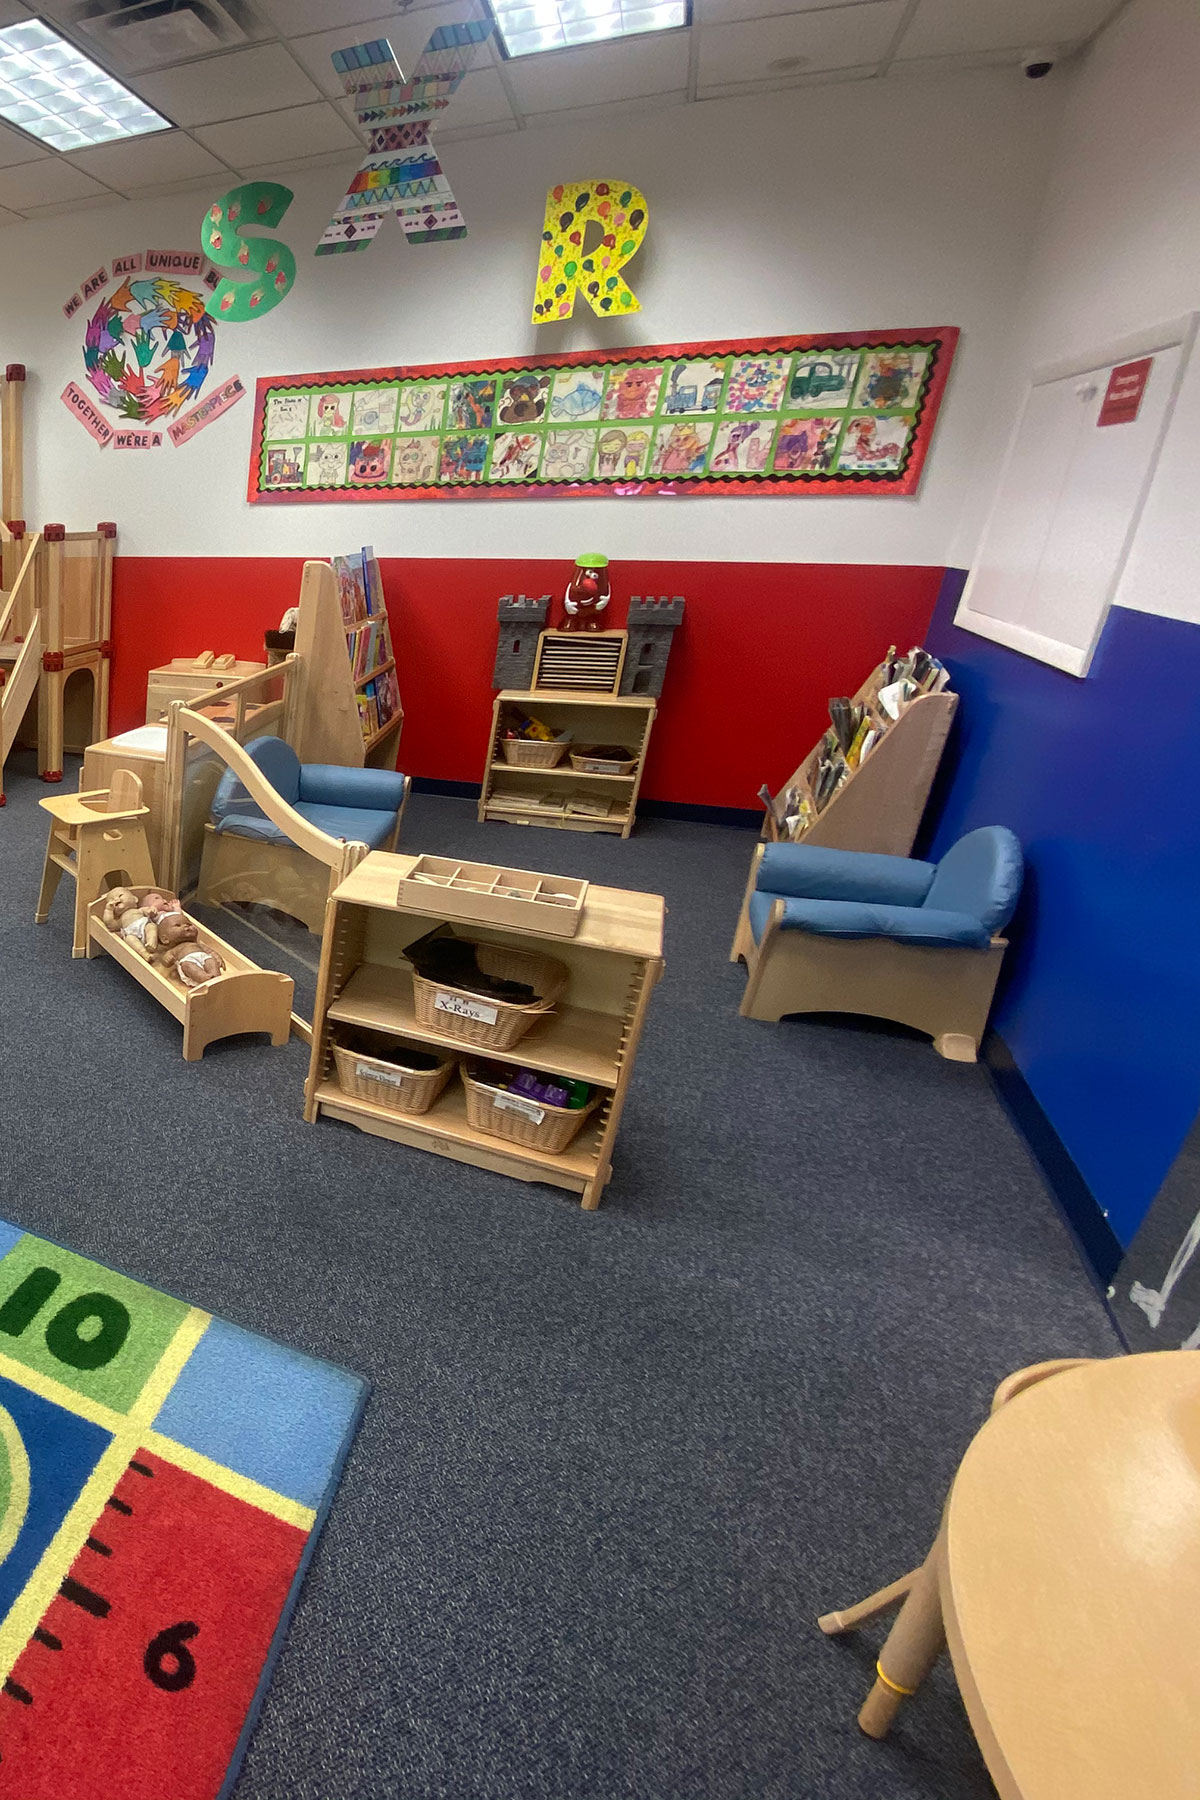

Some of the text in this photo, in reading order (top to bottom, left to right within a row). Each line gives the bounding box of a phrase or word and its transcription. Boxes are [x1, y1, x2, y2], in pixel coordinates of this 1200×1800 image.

[201, 181, 297, 322] S
[531, 179, 649, 324] R
[65, 297, 81, 314] WE
[84, 271, 108, 297] ARE
[115, 258, 137, 273] ALL
[150, 254, 200, 269] UNIQUE
[68, 387, 110, 440] TOGETHER
[116, 432, 162, 447] WE'RE A
[171, 379, 244, 441] MASTERPIECE
[440, 1000, 481, 1018] X-Rays
[143, 1620, 201, 1692] 6
